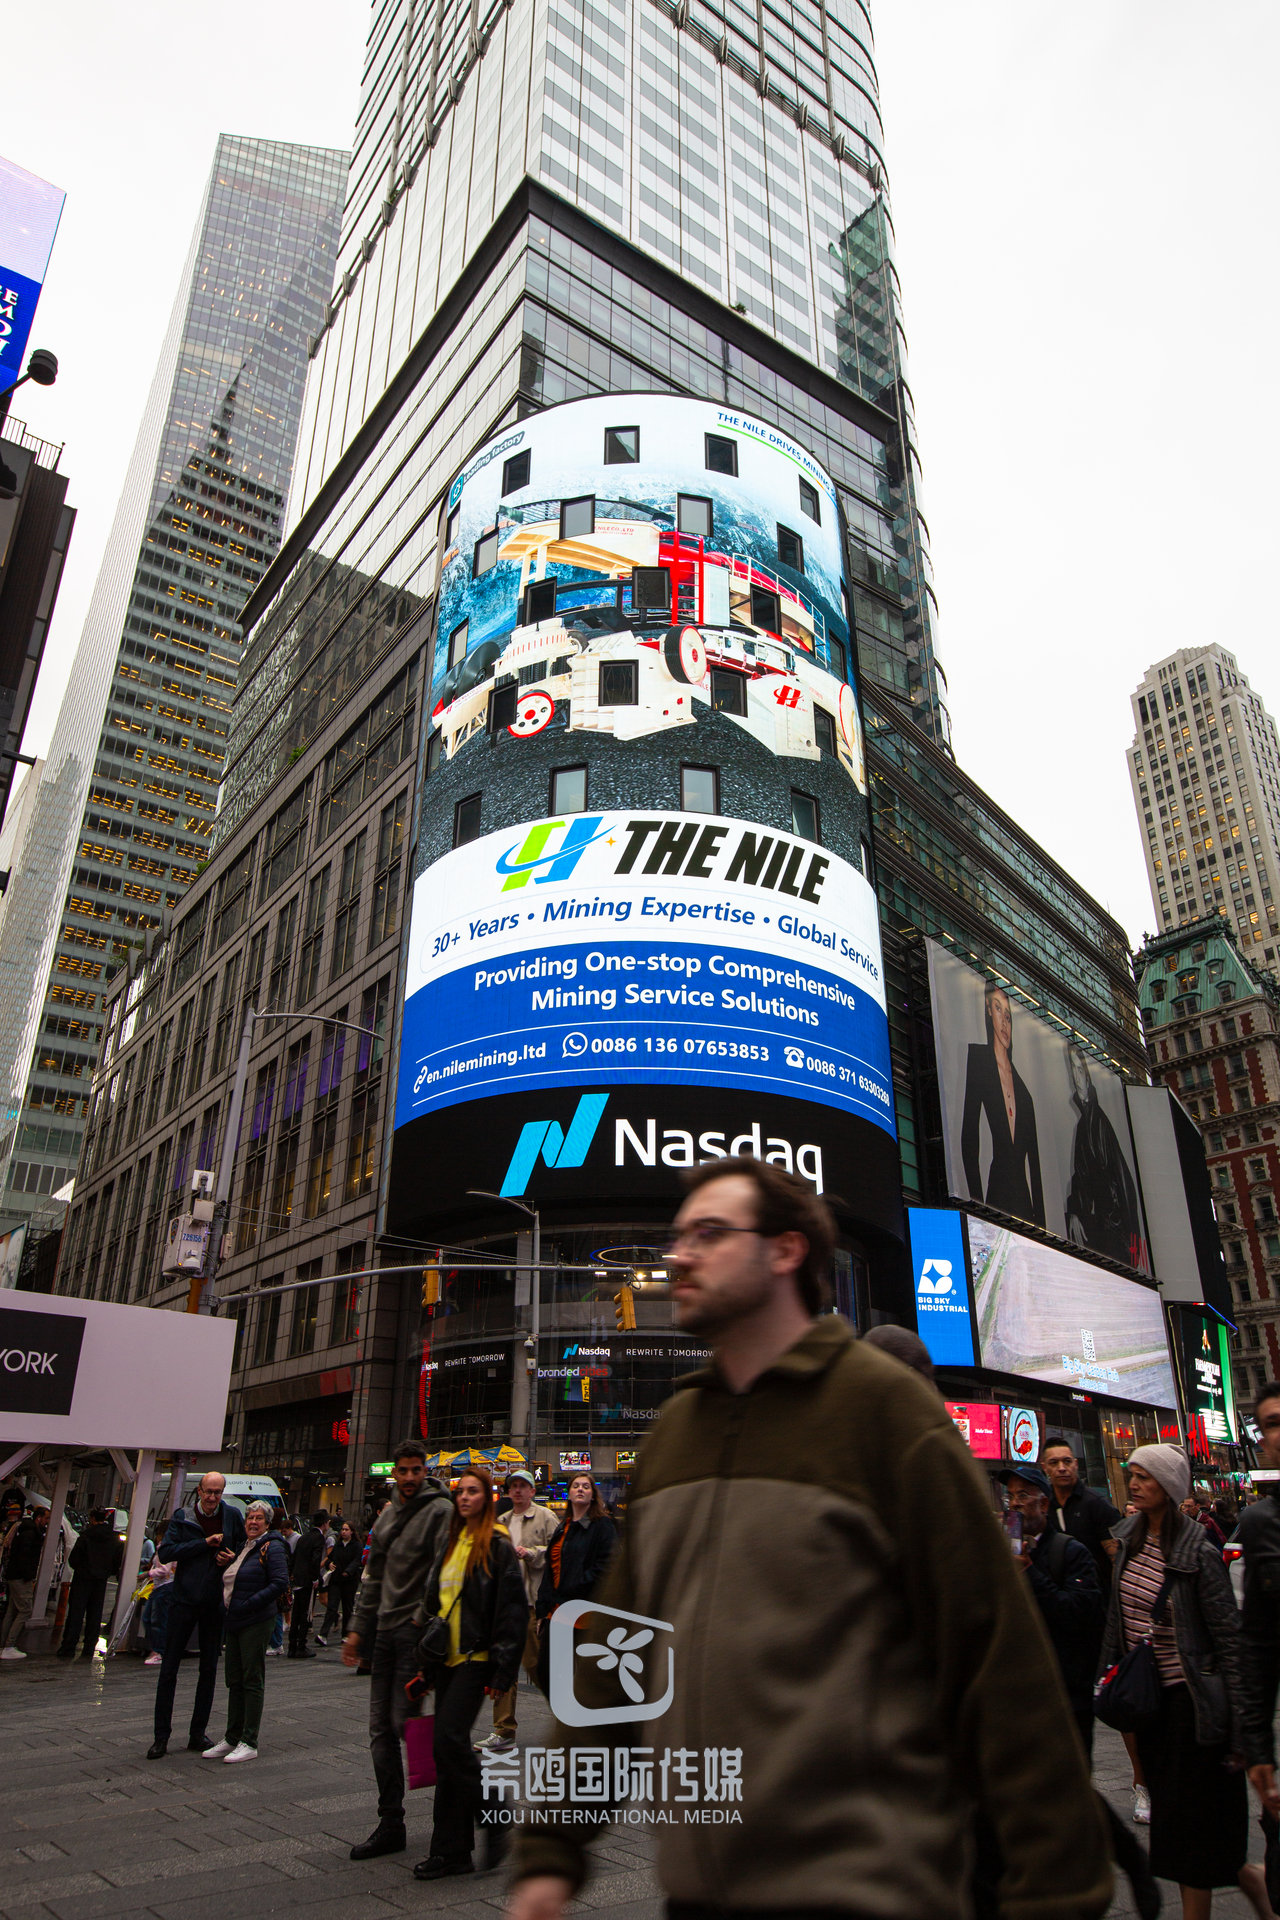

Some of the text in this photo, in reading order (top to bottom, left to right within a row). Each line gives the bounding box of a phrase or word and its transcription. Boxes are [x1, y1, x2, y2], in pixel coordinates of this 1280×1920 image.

[464, 433, 524, 484] Leading factory
[717, 412, 739, 426] THE
[742, 421, 766, 437] NILE
[769, 433, 801, 460] DRIVES
[614, 821, 830, 905] THE NILE
[432, 896, 879, 982] 30+ Years Mining Expertise Global Service
[474, 951, 855, 1010] Providing One-stop Comprehensive
[532, 983, 819, 1027] Mining Service Solutions
[427, 1037, 770, 1084] en.nilemining.ltd 0086 136 07653853
[806, 1056, 836, 1077] 0086
[839, 1066, 856, 1086] 371
[615, 1118, 824, 1196] Nasdaq
[917, 1296, 951, 1305] BIG SKY
[918, 1303, 969, 1313] INDUSTRIAL
[444, 1357, 467, 1367] REWRITE
[469, 1353, 505, 1364] TOMORROW
[579, 1347, 611, 1357] Nasdaq
[626, 1348, 664, 1356] REWRITE
